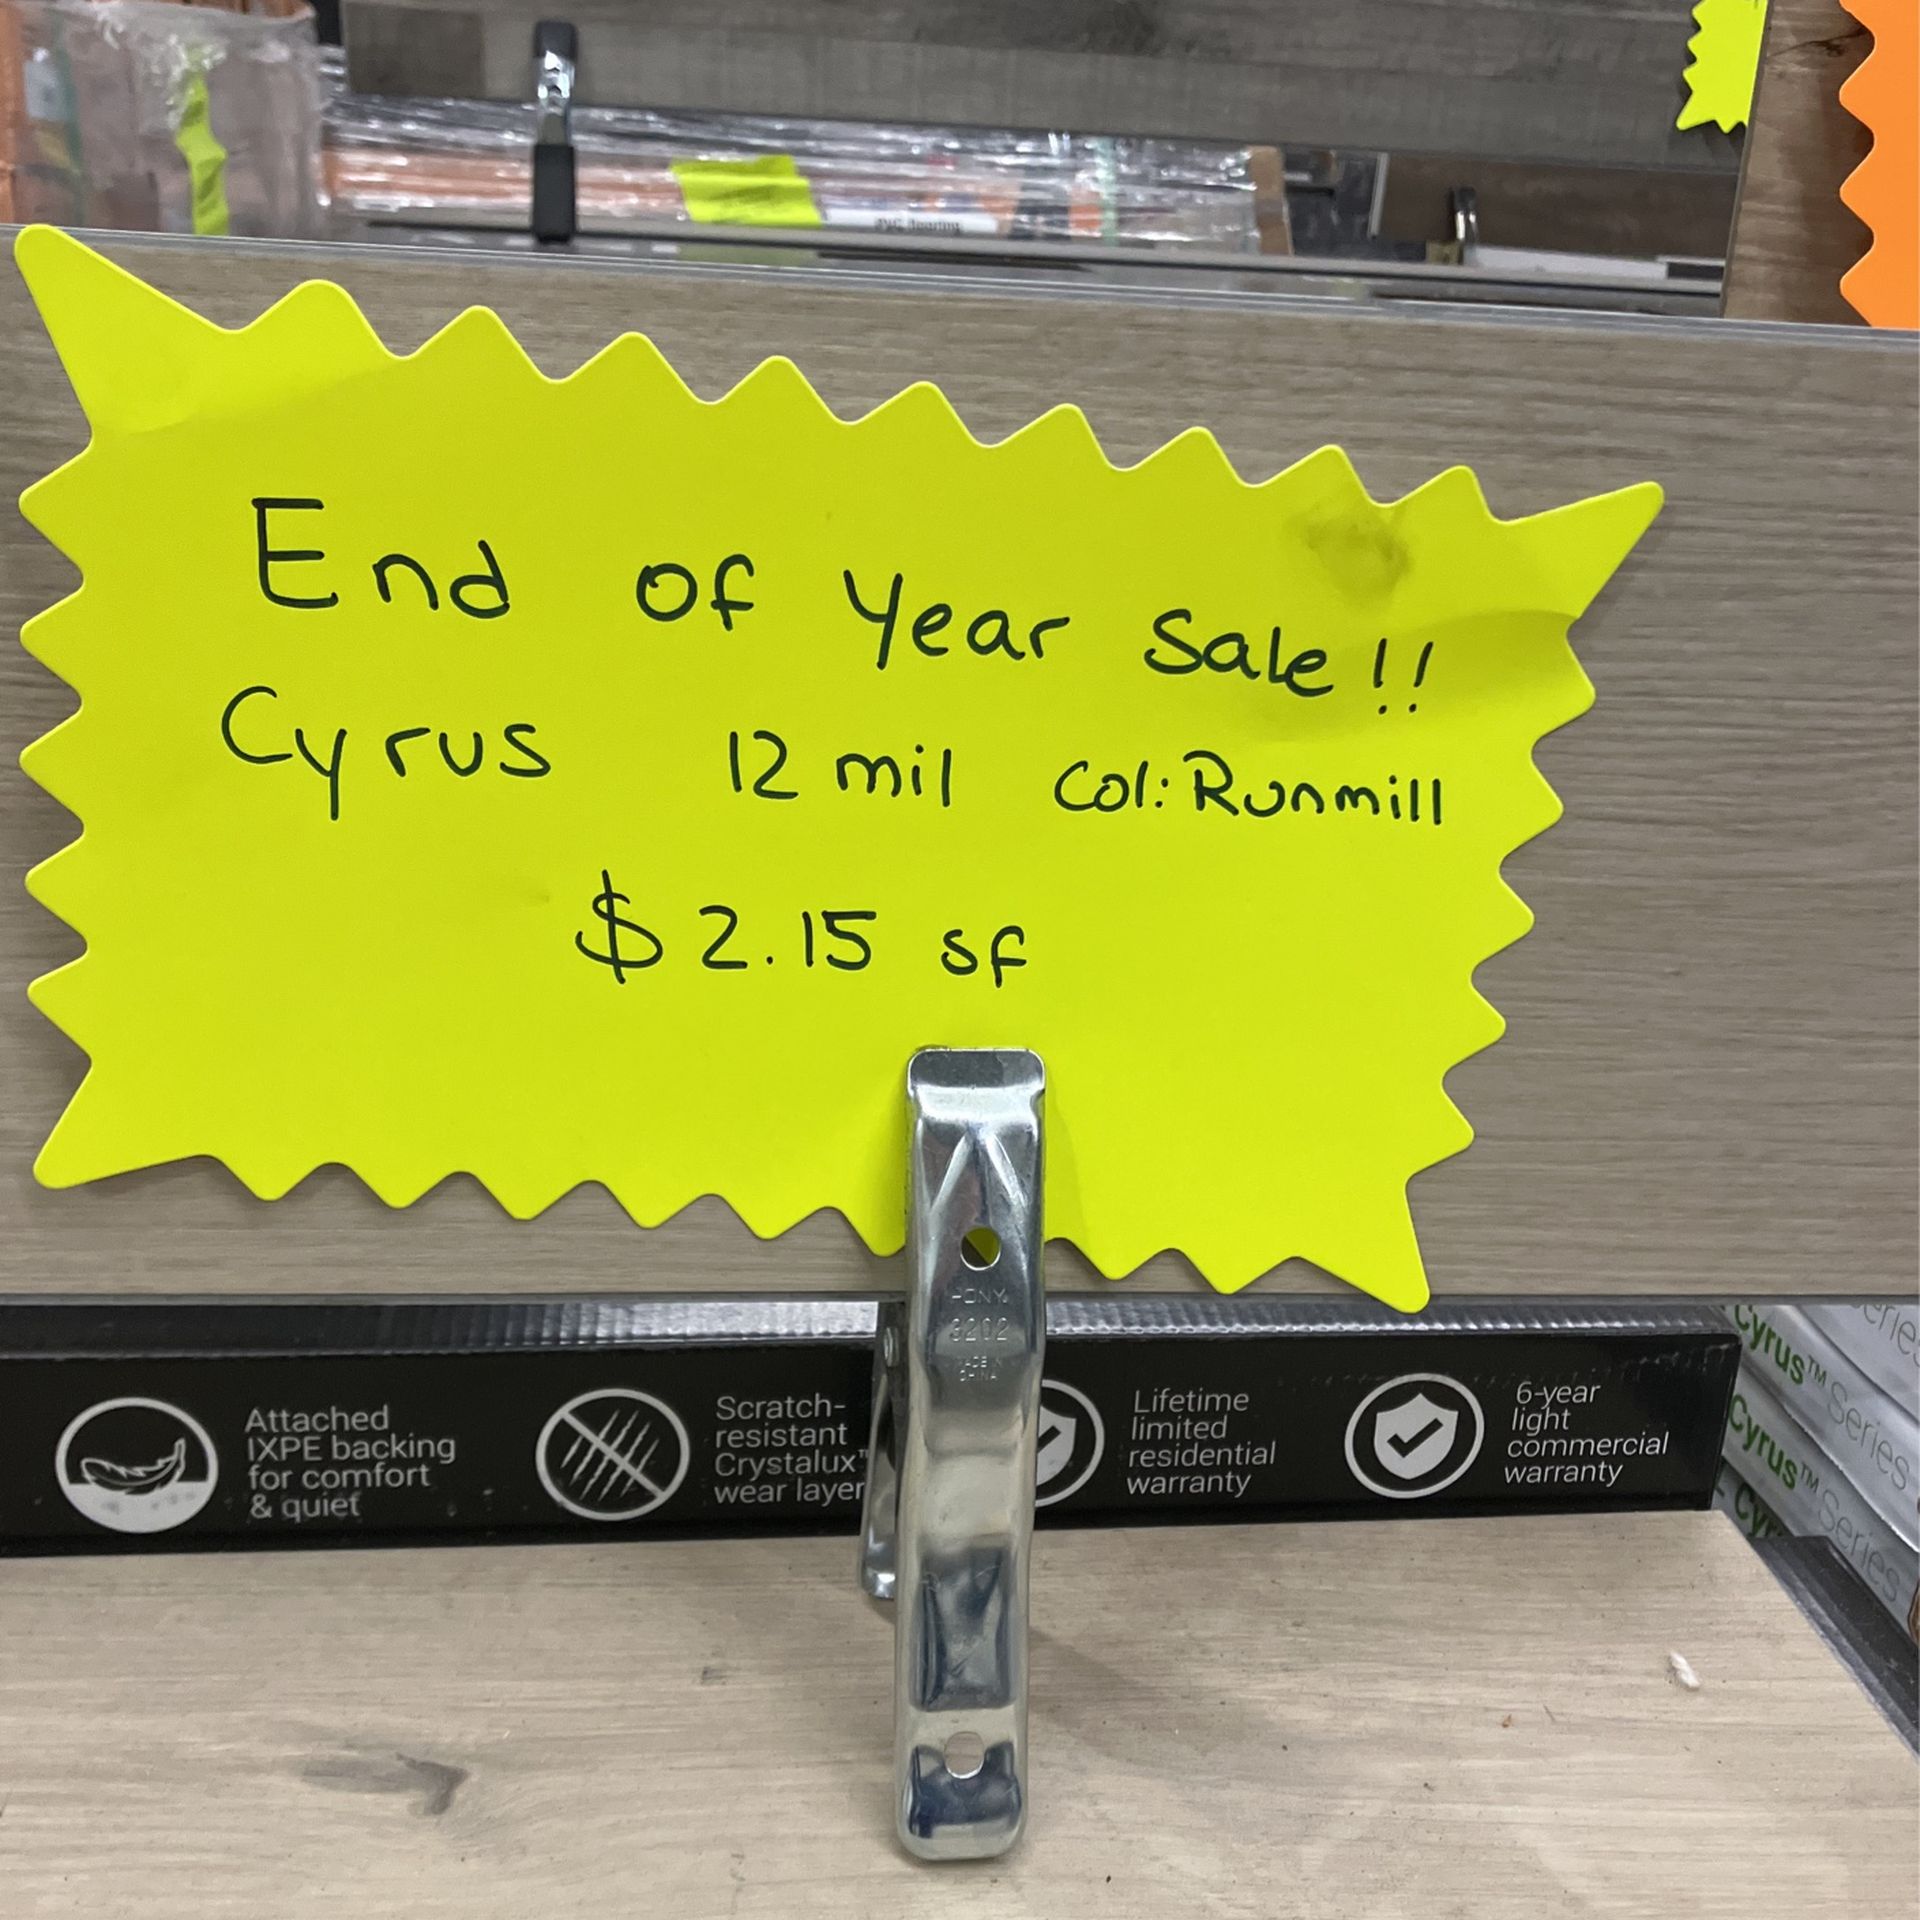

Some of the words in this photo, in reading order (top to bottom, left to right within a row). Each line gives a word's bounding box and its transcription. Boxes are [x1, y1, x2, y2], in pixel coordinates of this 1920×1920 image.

[251, 497, 511, 619] End
[636, 553, 755, 632] of
[221, 685, 551, 821] Cyrus
[729, 730, 799, 800] 12
[836, 744, 952, 808] mil
[941, 925, 1027, 988] sf
[951, 1317, 1009, 1342] 3202
[715, 1392, 846, 1420] Scratch-
[1133, 1387, 1250, 1413] Lifetime
[1516, 1381, 1602, 1409] 6-year
[244, 1404, 390, 1433] Attached
[1130, 1415, 1228, 1440] limited
[1511, 1407, 1571, 1437] light
[248, 1436, 323, 1462] IXPE
[331, 1432, 456, 1465] backing
[715, 1422, 848, 1448] resistant
[1507, 1431, 1670, 1458] commercial
[1828, 1382, 1910, 1490] Series
[1128, 1441, 1277, 1468] residential
[249, 1464, 293, 1491] for
[302, 1461, 431, 1490] comfort
[1127, 1471, 1252, 1499] warranty
[1504, 1460, 1624, 1489] warranty
[714, 1484, 788, 1504] wear
[796, 1478, 865, 1507] layer
[250, 1493, 273, 1519] &
[281, 1491, 361, 1524] quiet
[1818, 1489, 1900, 1602] Series
